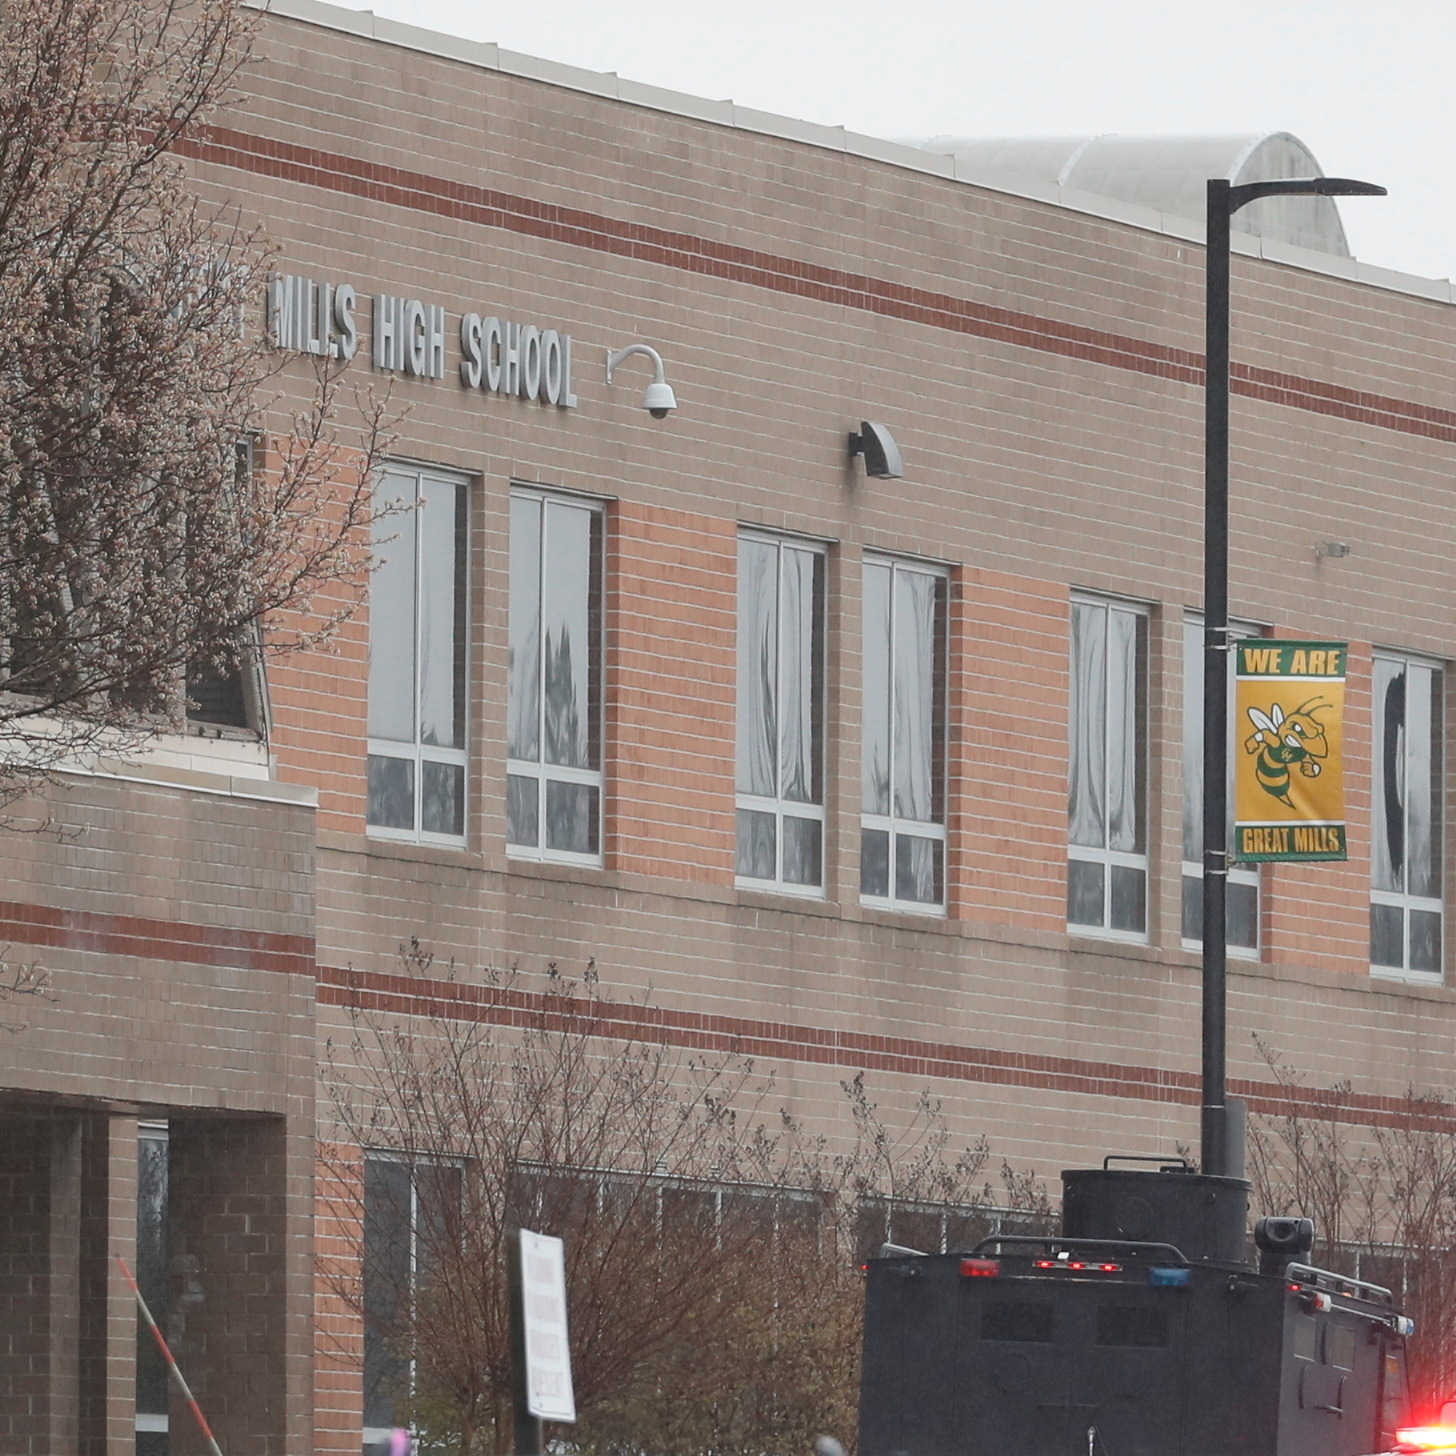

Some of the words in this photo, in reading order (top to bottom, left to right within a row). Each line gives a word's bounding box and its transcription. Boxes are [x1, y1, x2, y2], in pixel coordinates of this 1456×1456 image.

[268, 273, 357, 360] MILLS
[373, 294, 444, 379] HIGH
[461, 312, 578, 409] SCHOOL
[1244, 648, 1282, 673] WE
[1290, 650, 1340, 675] ARE
[1243, 828, 1289, 853] GREAT
[1294, 828, 1339, 852] MILLS
